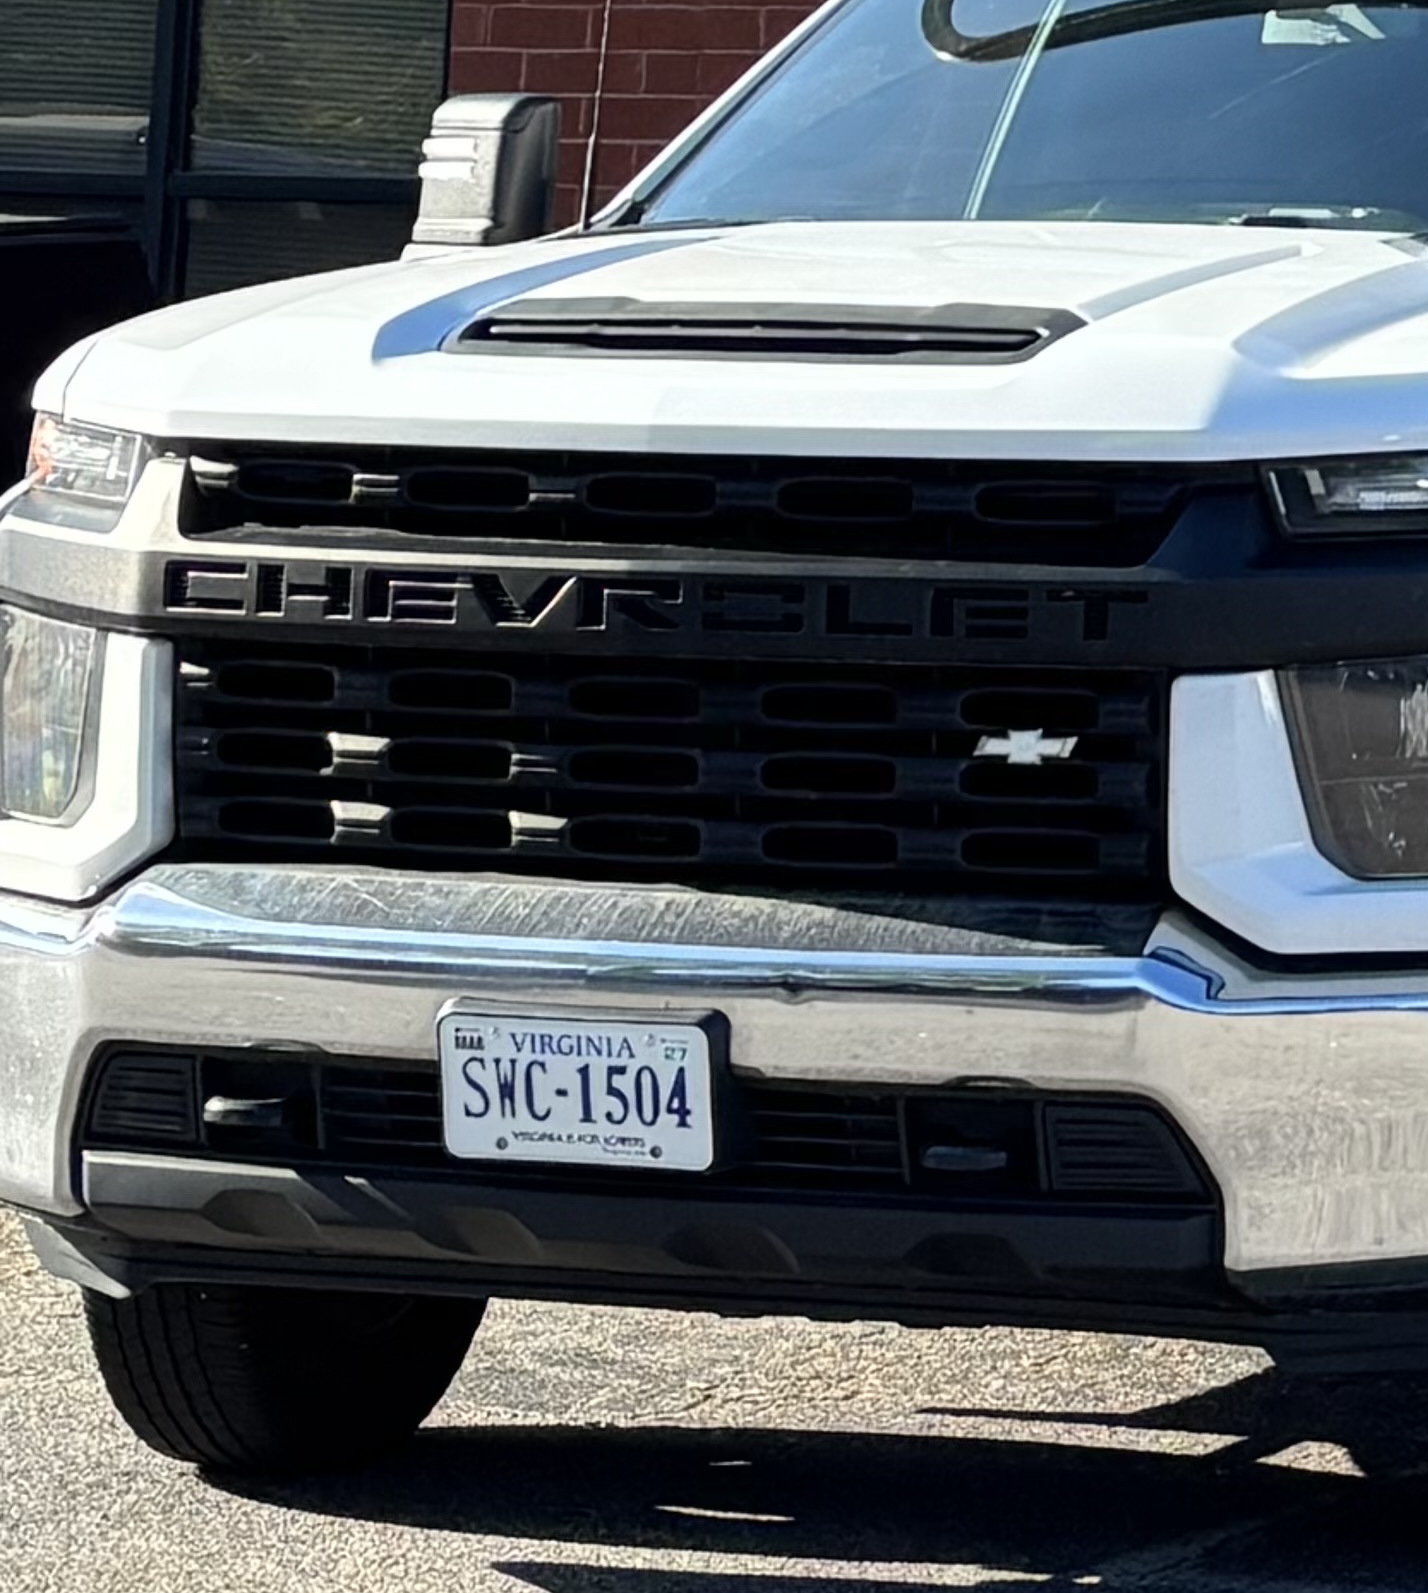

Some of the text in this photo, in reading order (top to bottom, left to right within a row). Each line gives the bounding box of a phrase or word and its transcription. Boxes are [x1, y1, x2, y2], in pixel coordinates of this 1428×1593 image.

[164, 560, 1149, 639] CHEVROLET
[509, 1031, 636, 1059] VIRGINIA
[461, 1056, 693, 1129] SWC-1504
